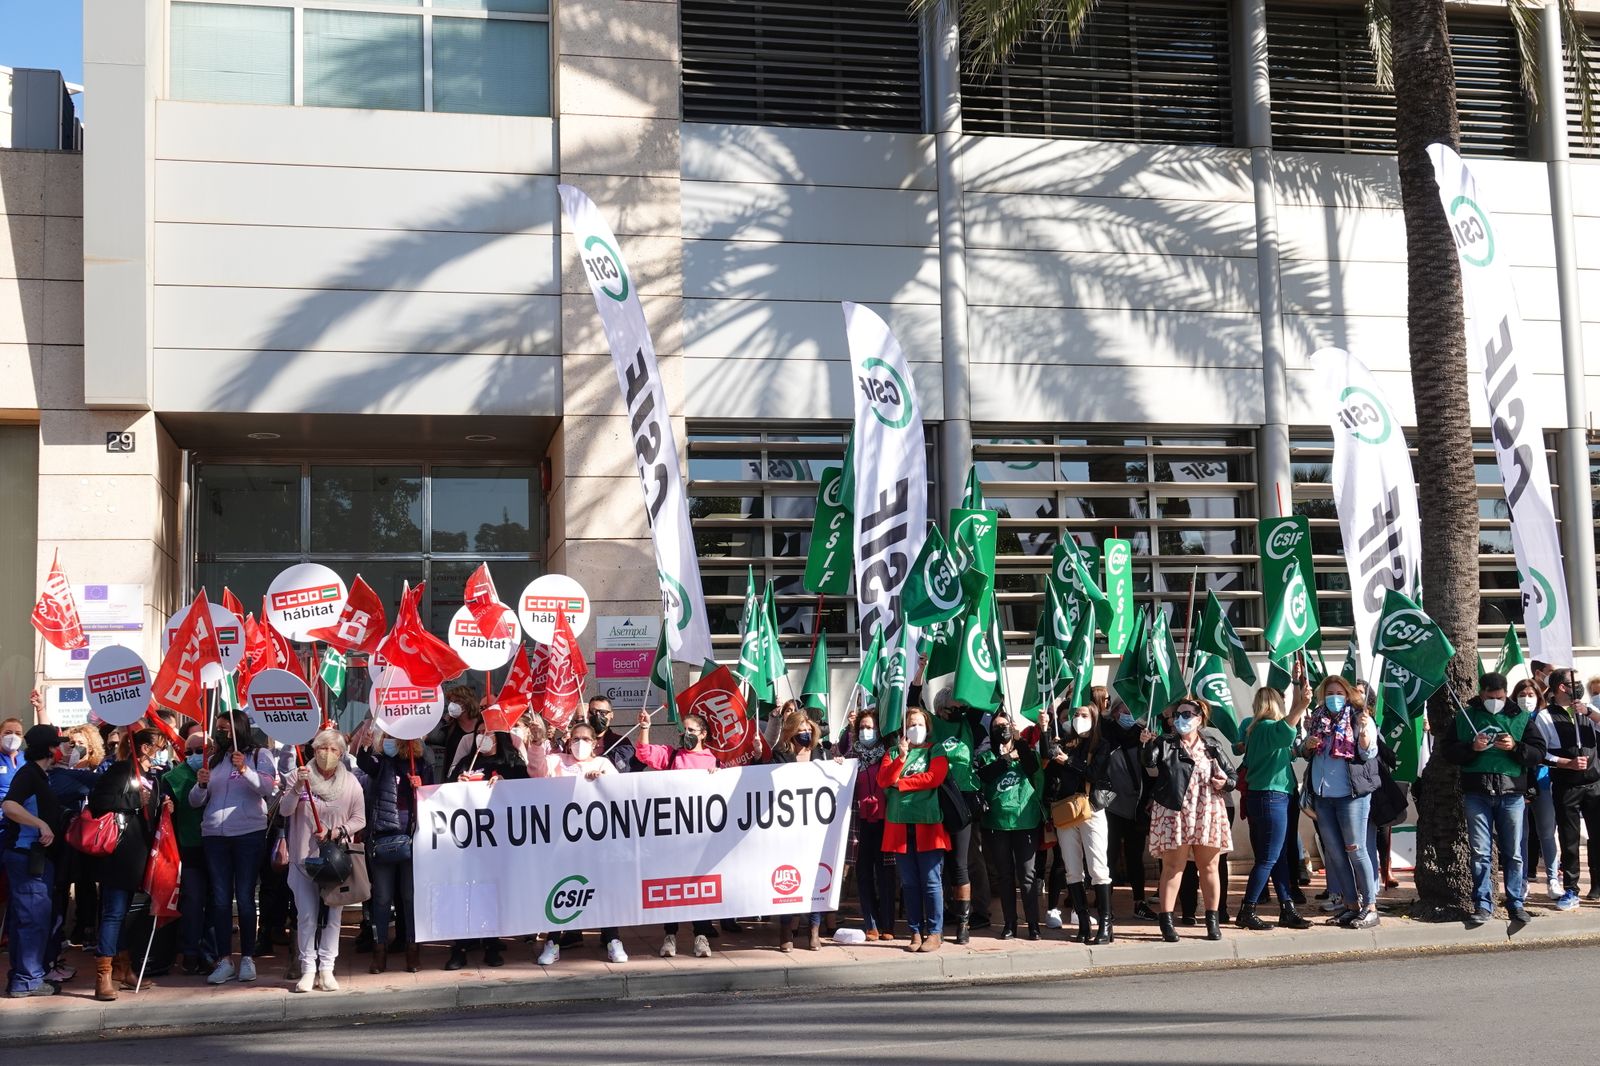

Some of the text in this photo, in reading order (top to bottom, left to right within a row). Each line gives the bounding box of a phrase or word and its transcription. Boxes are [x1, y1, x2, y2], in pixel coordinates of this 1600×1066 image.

[108, 433, 133, 450] 29
[1273, 531, 1304, 548] CSIF
[818, 512, 845, 588] CSIF
[275, 591, 319, 607] CCOO
[528, 599, 566, 610] CCOO
[283, 603, 334, 621] hábitat
[532, 612, 576, 624] hábat
[1116, 579, 1126, 651] CSIF
[1386, 620, 1434, 644] CSIF
[461, 636, 506, 650] hábitat
[91, 676, 128, 689] CCOO
[99, 687, 141, 705] hábitat
[255, 697, 294, 708] CCOO
[381, 690, 419, 701] CCOO
[264, 711, 309, 723] hábitat
[385, 704, 431, 717] hábitat
[705, 694, 744, 740] UGT
[430, 786, 837, 850] POR UN CONVENIO JUSTO
[553, 887, 595, 908] CSIF
[648, 880, 717, 902] CCOO
